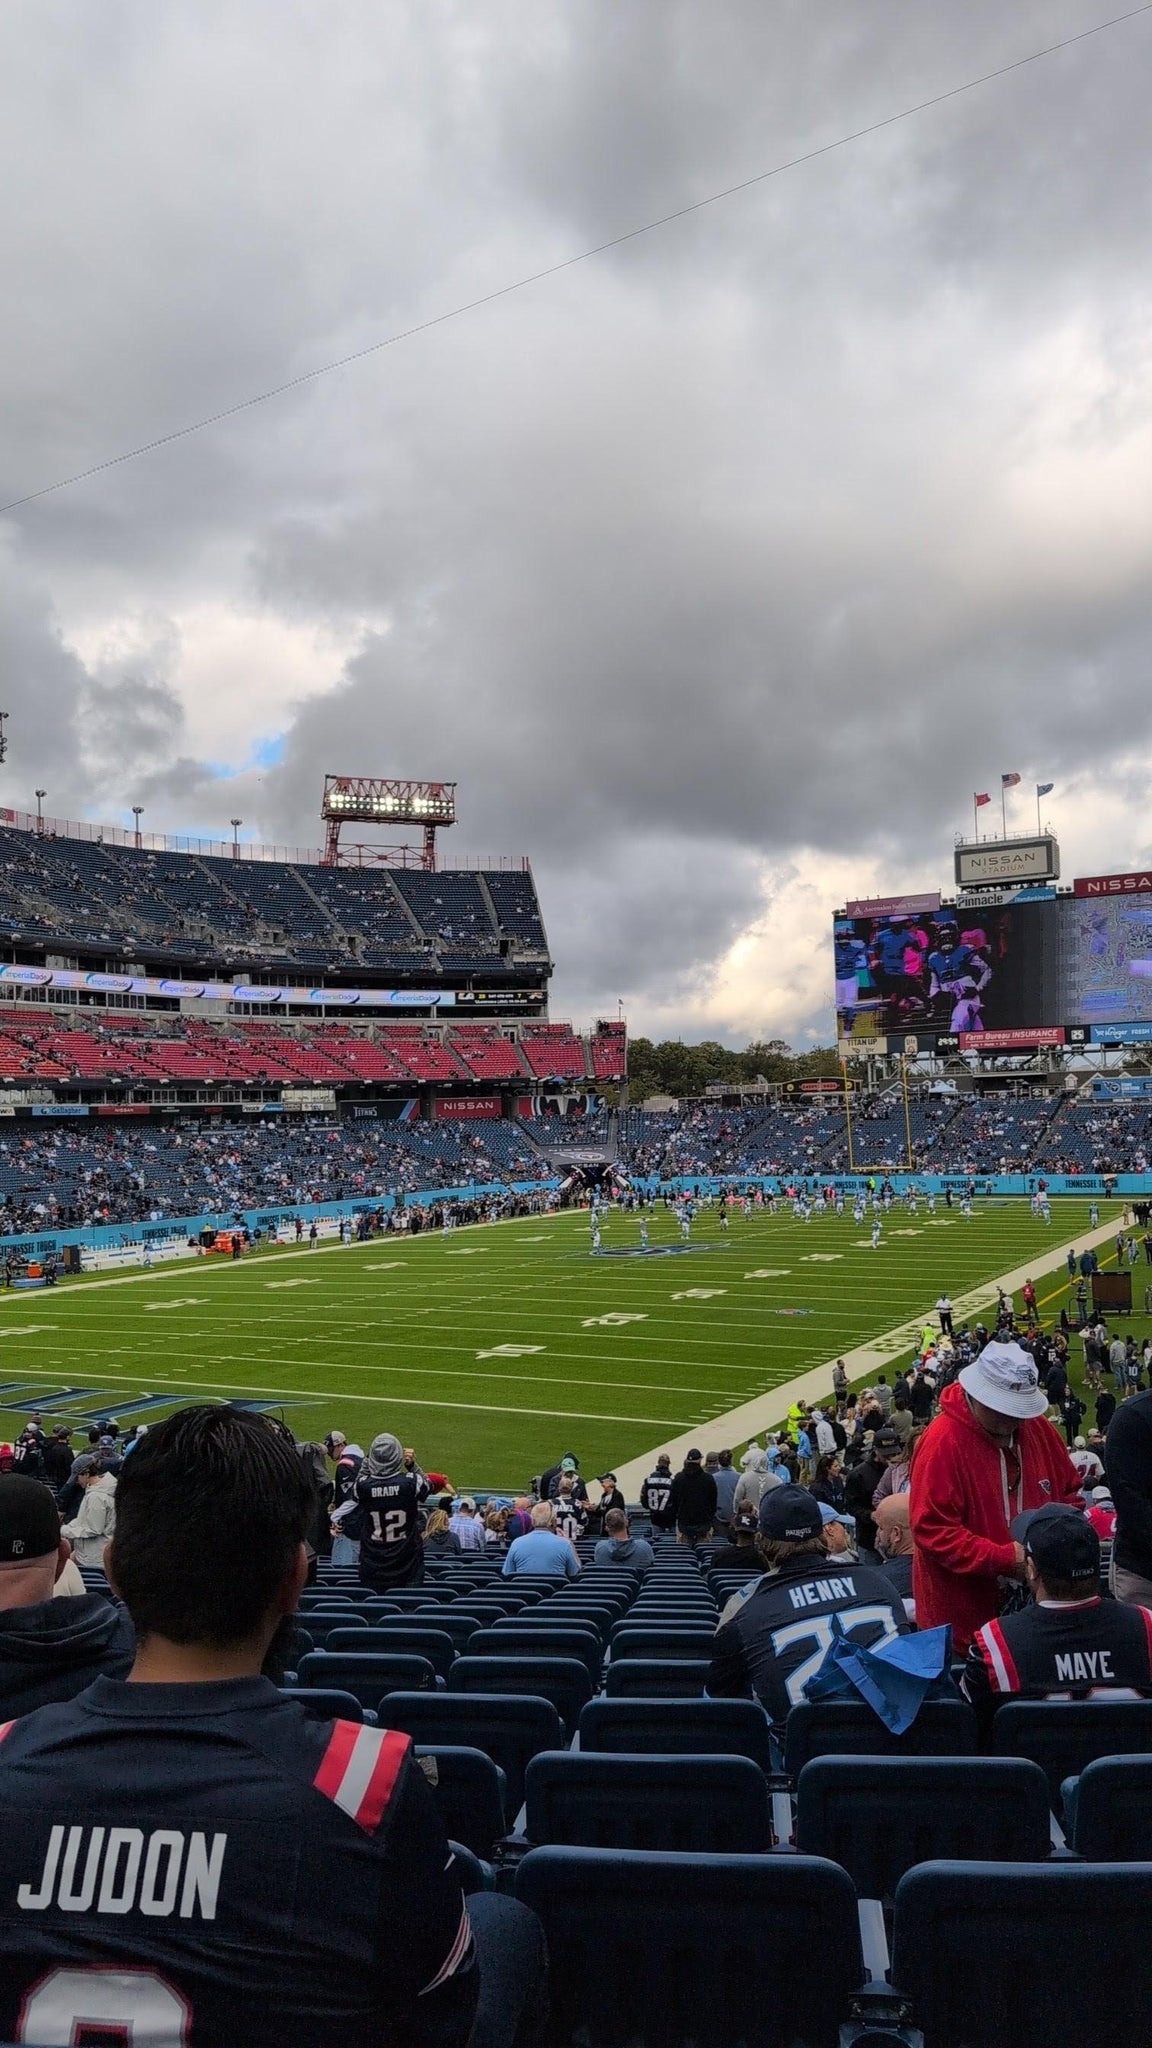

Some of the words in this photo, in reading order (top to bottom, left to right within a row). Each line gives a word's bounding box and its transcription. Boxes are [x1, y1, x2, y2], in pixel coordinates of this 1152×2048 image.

[971, 853, 1036, 867] NISSAN
[982, 864, 1025, 873] STADIUM
[1087, 877, 1152, 892] NISSA
[957, 894, 1004, 908] Pinnacle
[6, 972, 48, 982] ImperialDade
[91, 978, 130, 988] ImperialDade
[164, 984, 201, 993] ImperialDade
[238, 989, 276, 999] ImperialDade
[965, 1032, 985, 1041] Farm
[985, 1031, 1011, 1040] Bureau
[1012, 1029, 1058, 1038] INSURANCE
[1105, 1027, 1127, 1039] Kroger
[847, 1038, 867, 1046] TITAN
[868, 1037, 877, 1046] UP
[51, 1107, 82, 1115] Gallagher
[353, 1106, 378, 1117] TITANS
[444, 1102, 494, 1110] NISSAN
[1065, 1180, 1097, 1188] TENNESSEE
[142, 1227, 169, 1238] TENNESSEE
[37, 1240, 57, 1253] TOUGH
[475, 1343, 547, 1360] 10
[1129, 1366, 1138, 1376] 10
[371, 1485, 400, 1498] BRADY
[647, 1488, 670, 1511] 87
[370, 1510, 407, 1542] 12
[788, 1577, 857, 1609] HENRY
[1054, 1651, 1115, 1681] MAYE
[17, 1825, 228, 1921] JUDON
